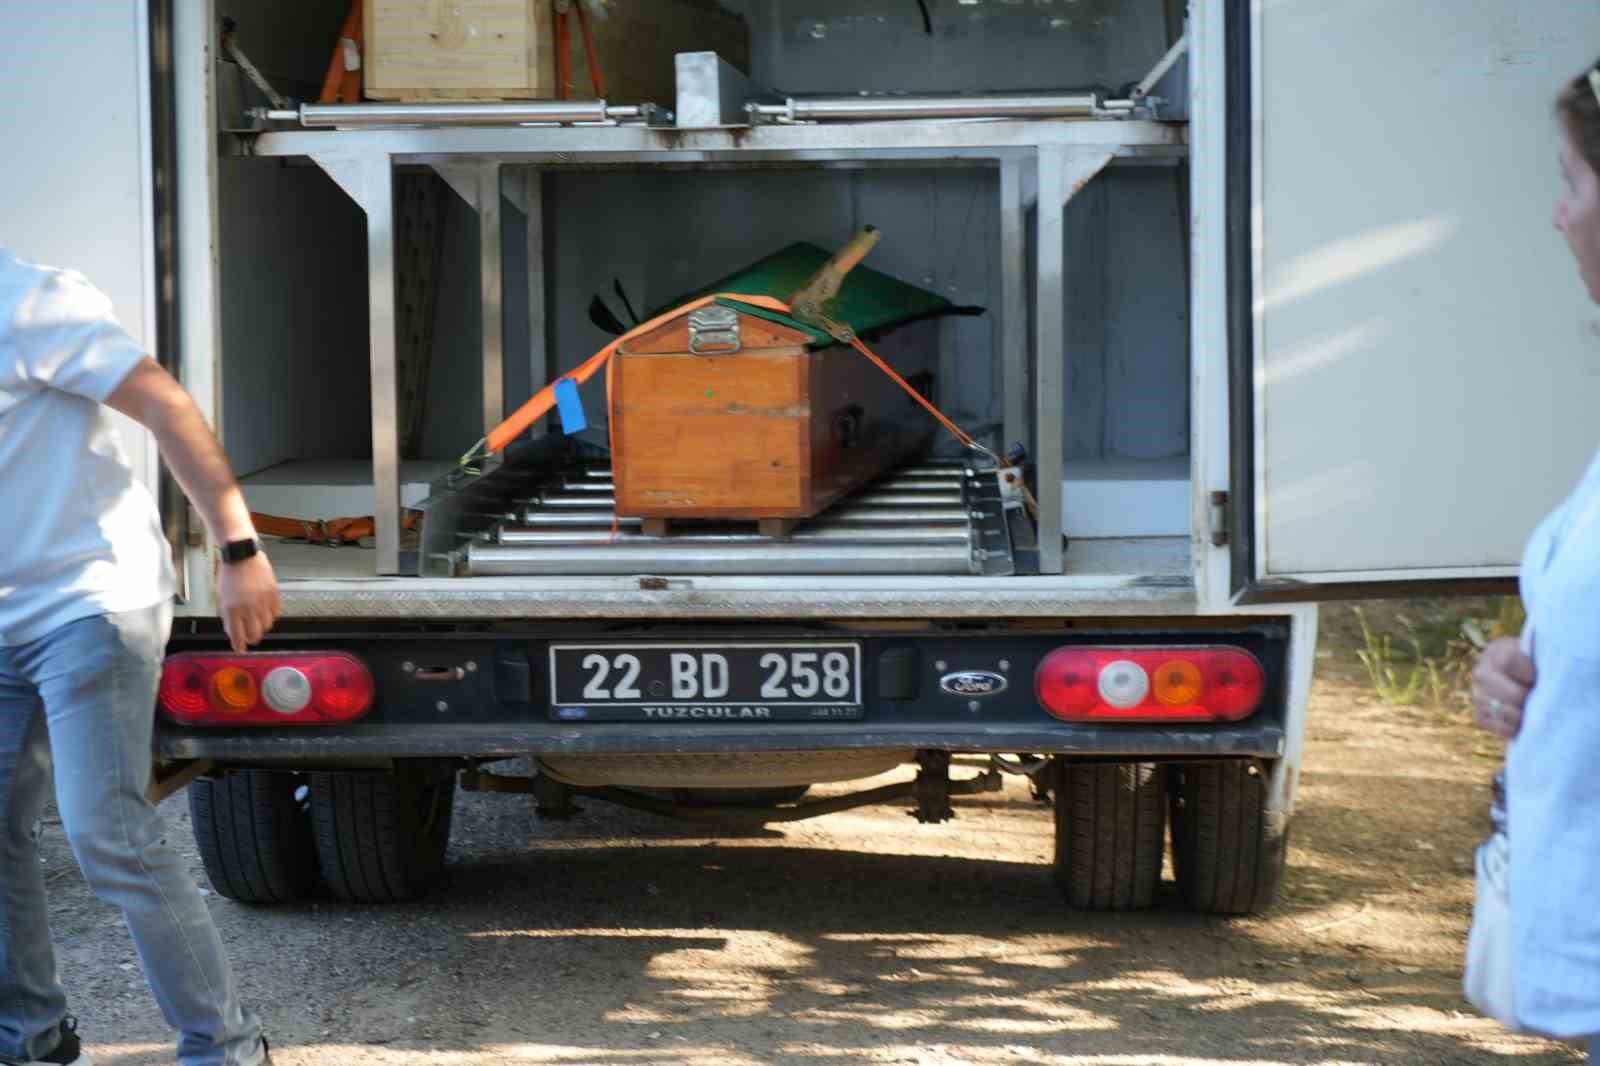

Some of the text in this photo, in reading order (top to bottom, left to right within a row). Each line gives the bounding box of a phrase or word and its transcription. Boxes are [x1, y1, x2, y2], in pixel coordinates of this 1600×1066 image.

[582, 652, 850, 699] 22 BD 258
[954, 675, 994, 692] Ford
[641, 706, 771, 718] TUZCULAR
